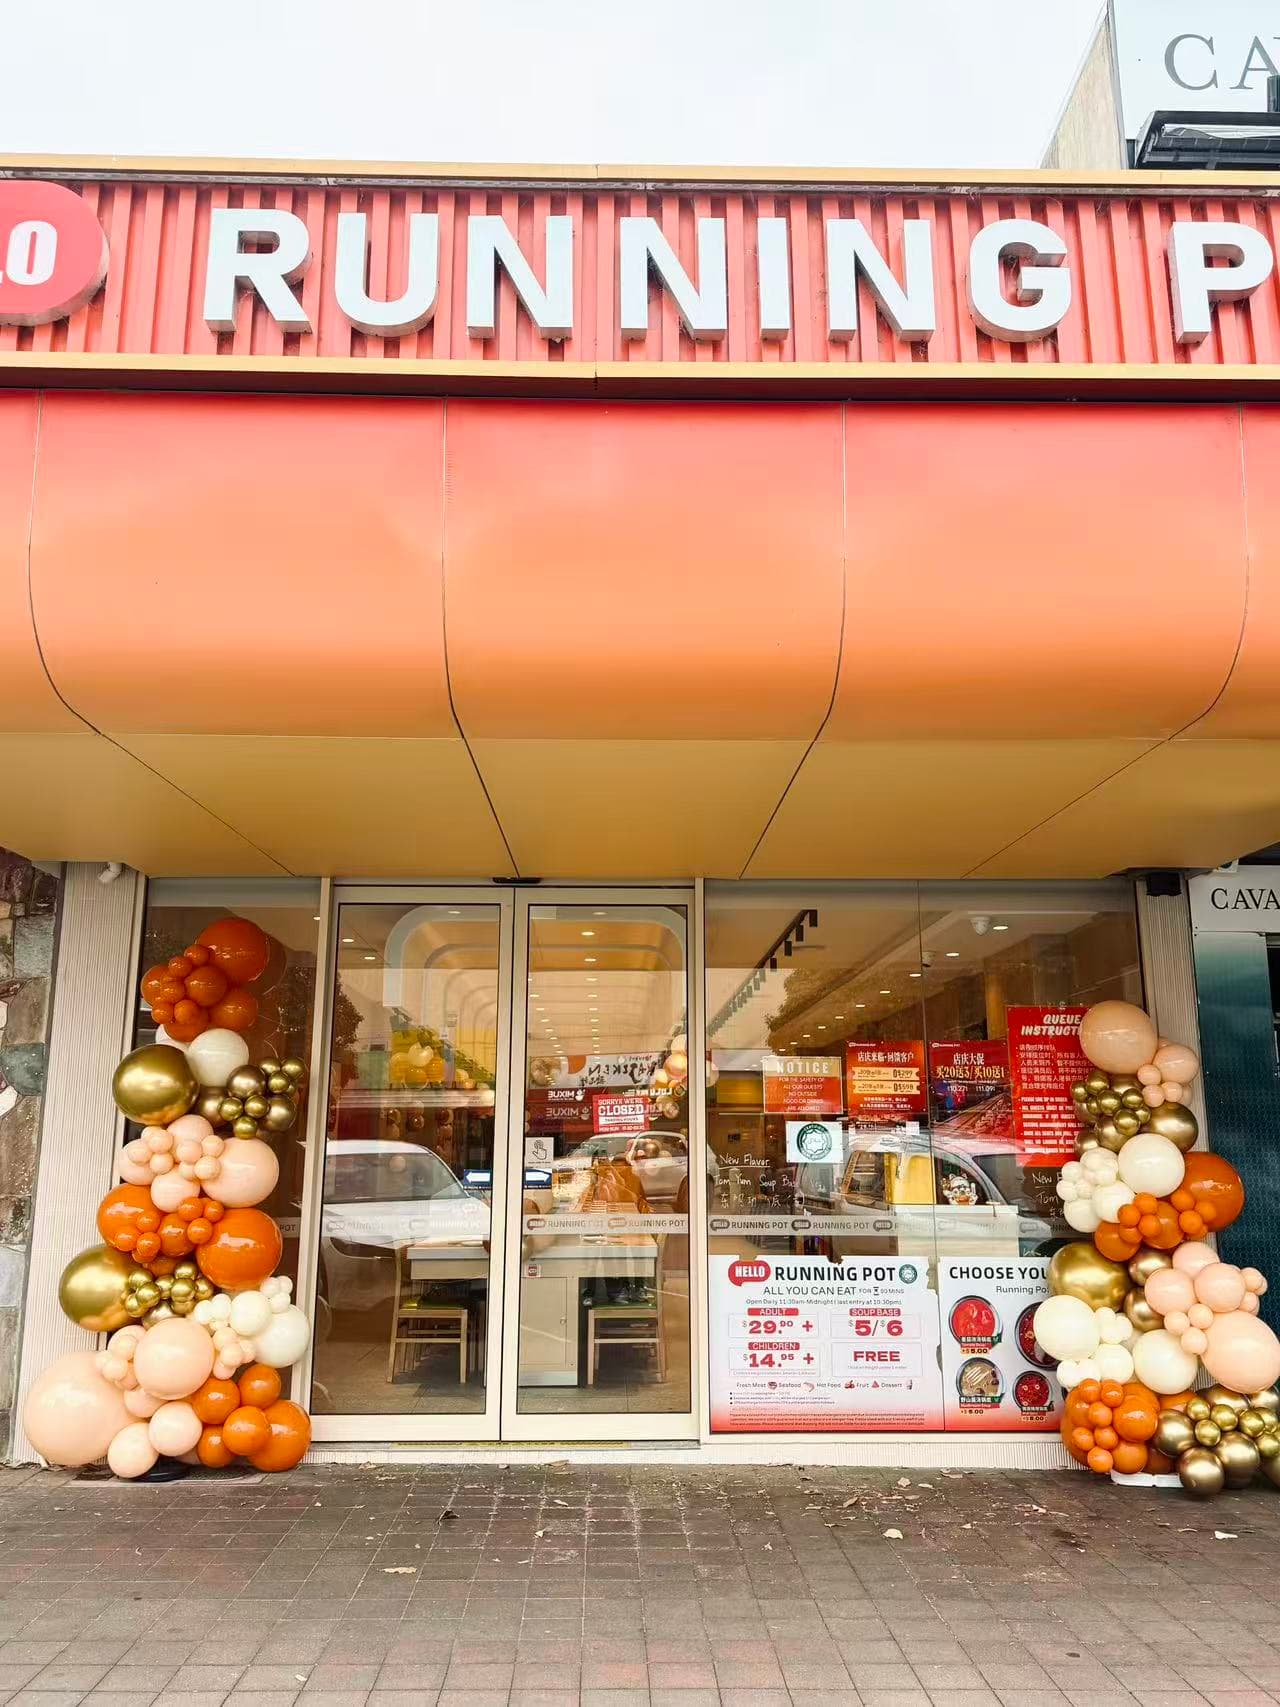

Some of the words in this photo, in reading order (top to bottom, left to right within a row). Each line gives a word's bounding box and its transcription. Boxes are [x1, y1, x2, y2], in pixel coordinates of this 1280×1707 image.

[1165, 33, 1280, 90] CA
[0, 220, 58, 286] O
[203, 208, 1072, 340] RUNNING
[1043, 1014, 1082, 1024] QUEUE
[776, 1061, 829, 1074] NOTICE
[598, 1104, 644, 1116] CLOSED
[720, 1153, 740, 1165] New
[743, 1153, 770, 1166] Flavor
[713, 1174, 731, 1186] Tom
[759, 1174, 777, 1192] Soup
[1032, 1171, 1052, 1184] New
[1036, 1191, 1058, 1204] Tom
[548, 1220, 586, 1228] RUNNING
[629, 1220, 667, 1228] RUNNING
[731, 1221, 770, 1229] RUNNING
[772, 1221, 788, 1229] POT
[812, 1221, 852, 1230] RUNNING
[853, 1222, 870, 1230] POT
[735, 1265, 766, 1278] HELLO
[775, 1266, 857, 1281] RUNNING
[863, 1267, 896, 1281] POT
[949, 1266, 1014, 1280] CHOOSE
[763, 1286, 784, 1296] ALL
[786, 1286, 809, 1296] YOU
[810, 1286, 835, 1296] CAN
[837, 1286, 857, 1296] EAT
[996, 1285, 1034, 1295] Running
[759, 1308, 787, 1316] ADULT
[851, 1308, 876, 1316] SOUP
[877, 1308, 899, 1316] BASE
[752, 1342, 796, 1350] CHILDREN
[853, 1351, 901, 1362] FREE
